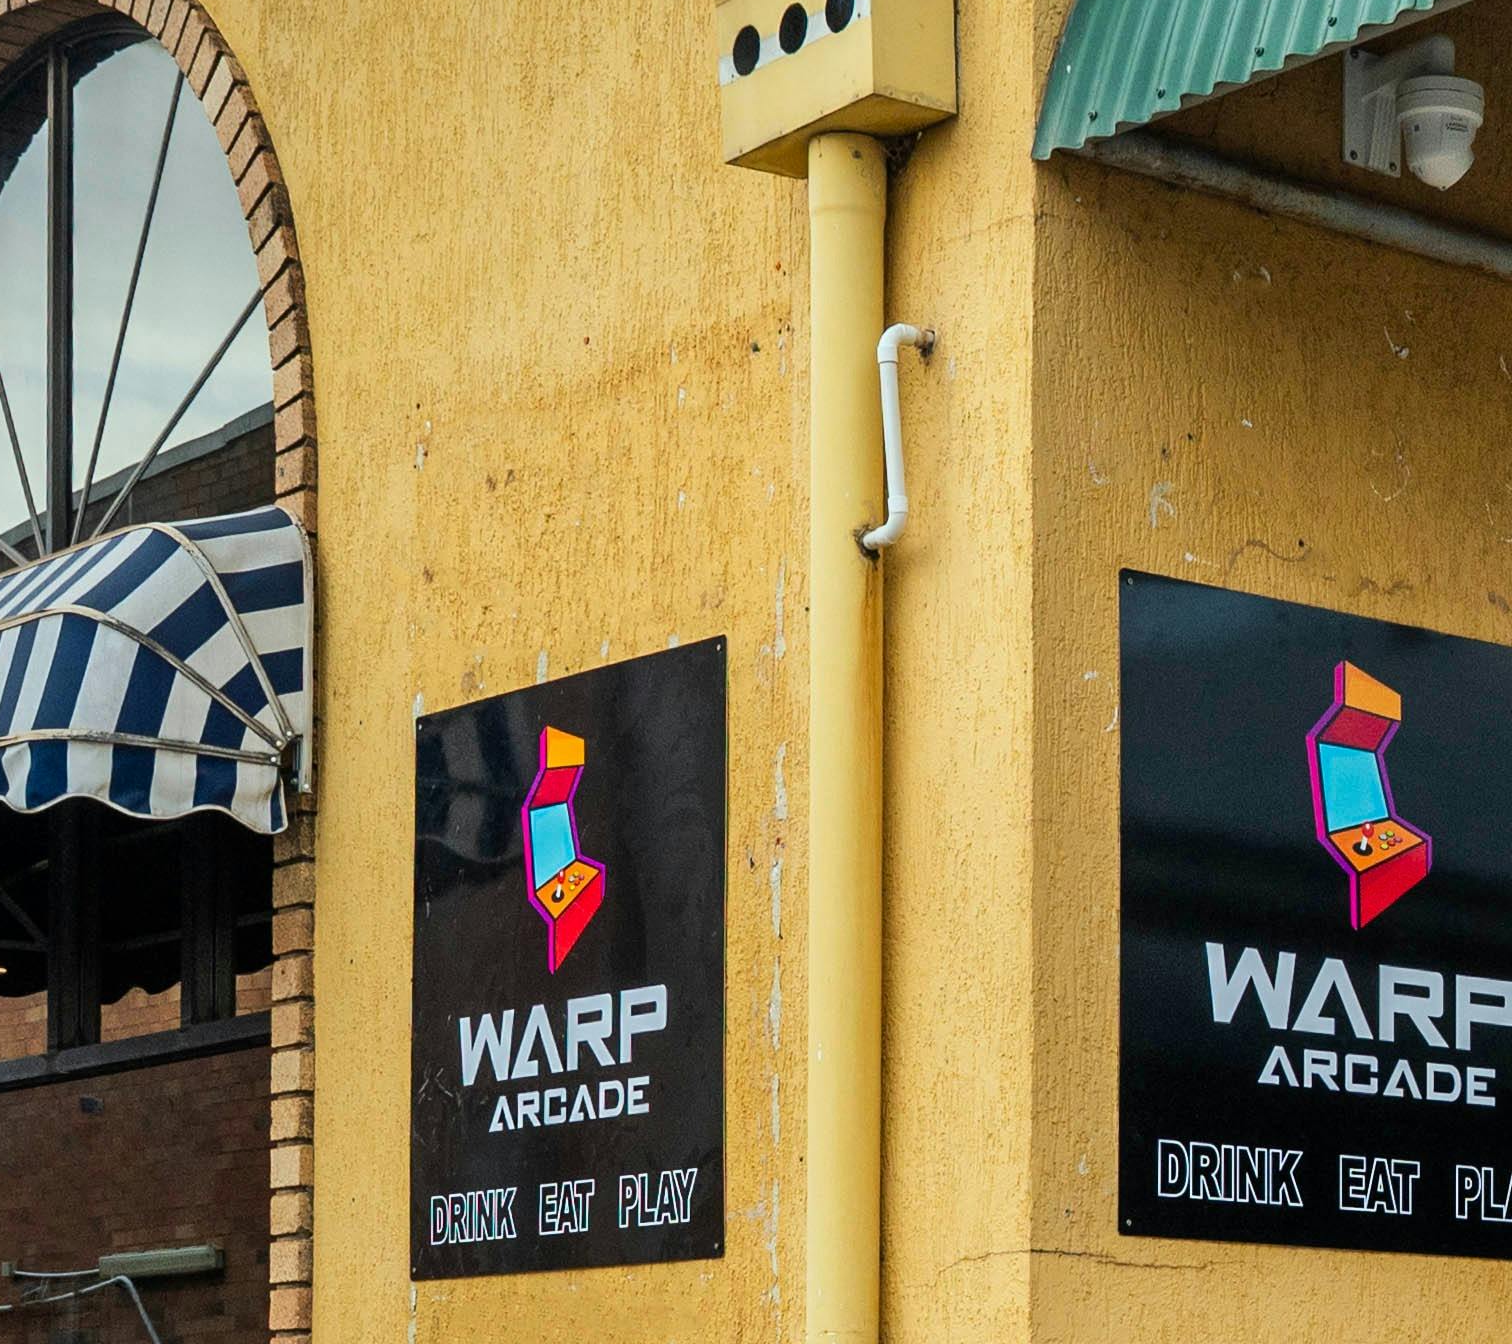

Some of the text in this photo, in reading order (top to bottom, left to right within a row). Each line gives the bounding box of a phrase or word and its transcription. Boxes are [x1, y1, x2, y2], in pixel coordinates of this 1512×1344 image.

[459, 984, 667, 1087] WARP
[488, 1075, 650, 1133] ARCADE
[1257, 1045, 1497, 1107] ARCADE
[430, 1168, 697, 1246] DRINK EAT PLAY
[1157, 1139, 1303, 1208] DRINK
[1339, 1154, 1420, 1215] EAT
